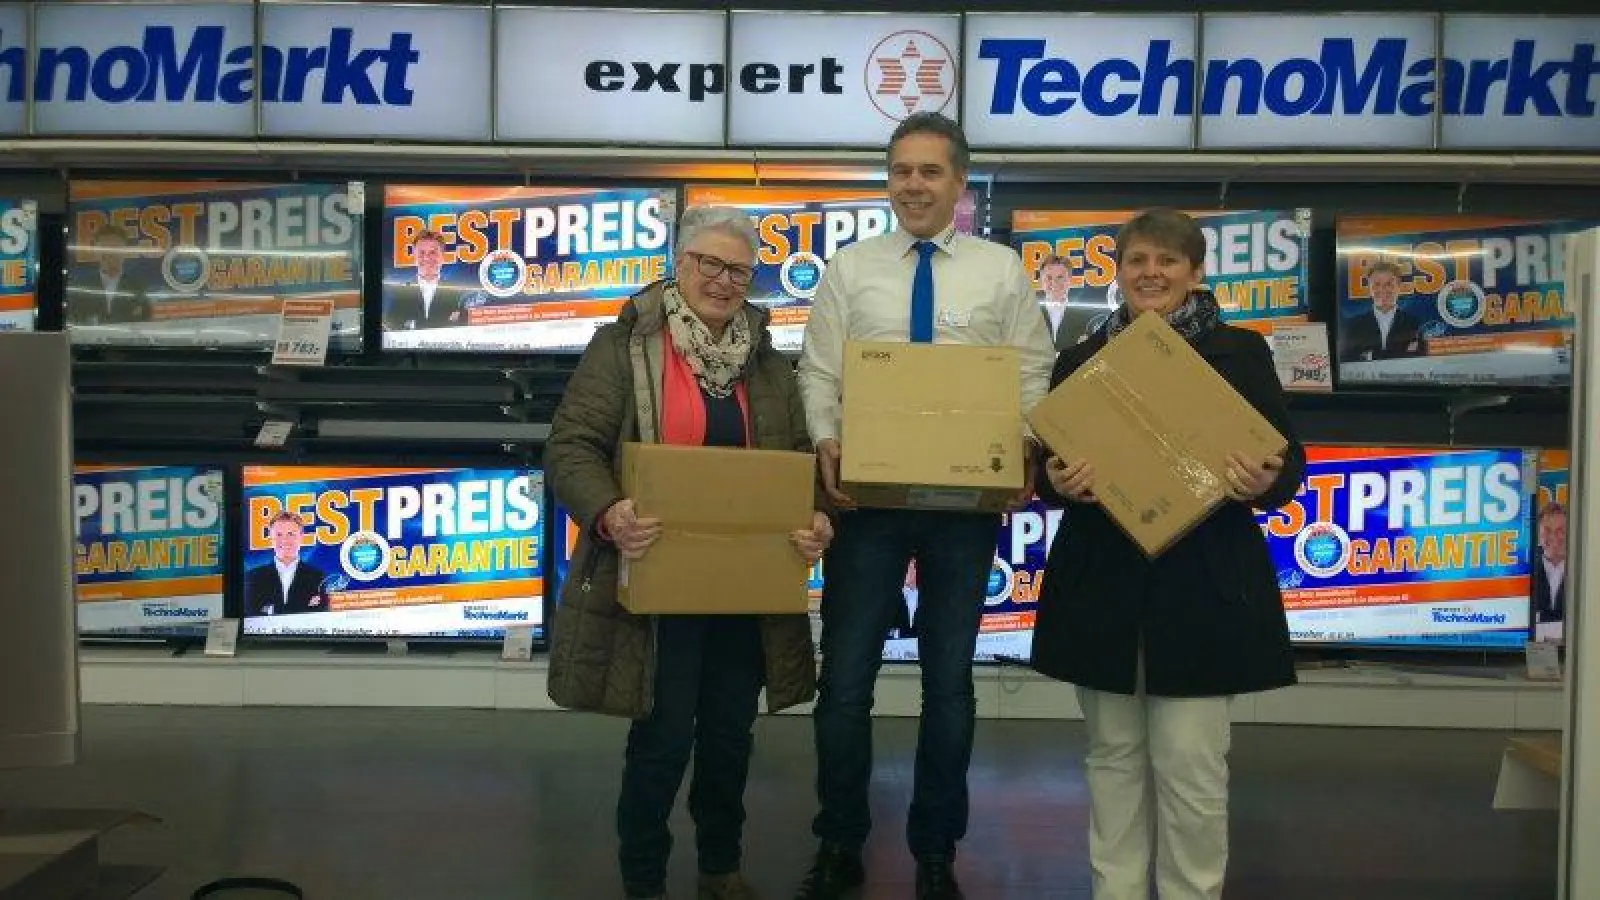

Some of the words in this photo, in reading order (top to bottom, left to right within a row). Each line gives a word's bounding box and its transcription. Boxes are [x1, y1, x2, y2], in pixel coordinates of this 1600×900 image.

[584, 58, 844, 102] expert
[978, 38, 1600, 117] TechnoMarkt
[523, 253, 667, 295] GARANTIE
[1482, 289, 1563, 326] GARA
[387, 535, 539, 579] GARANTIE
[1348, 530, 1519, 576] GARANTIE
[1431, 610, 1507, 624] TechnoMarkt
